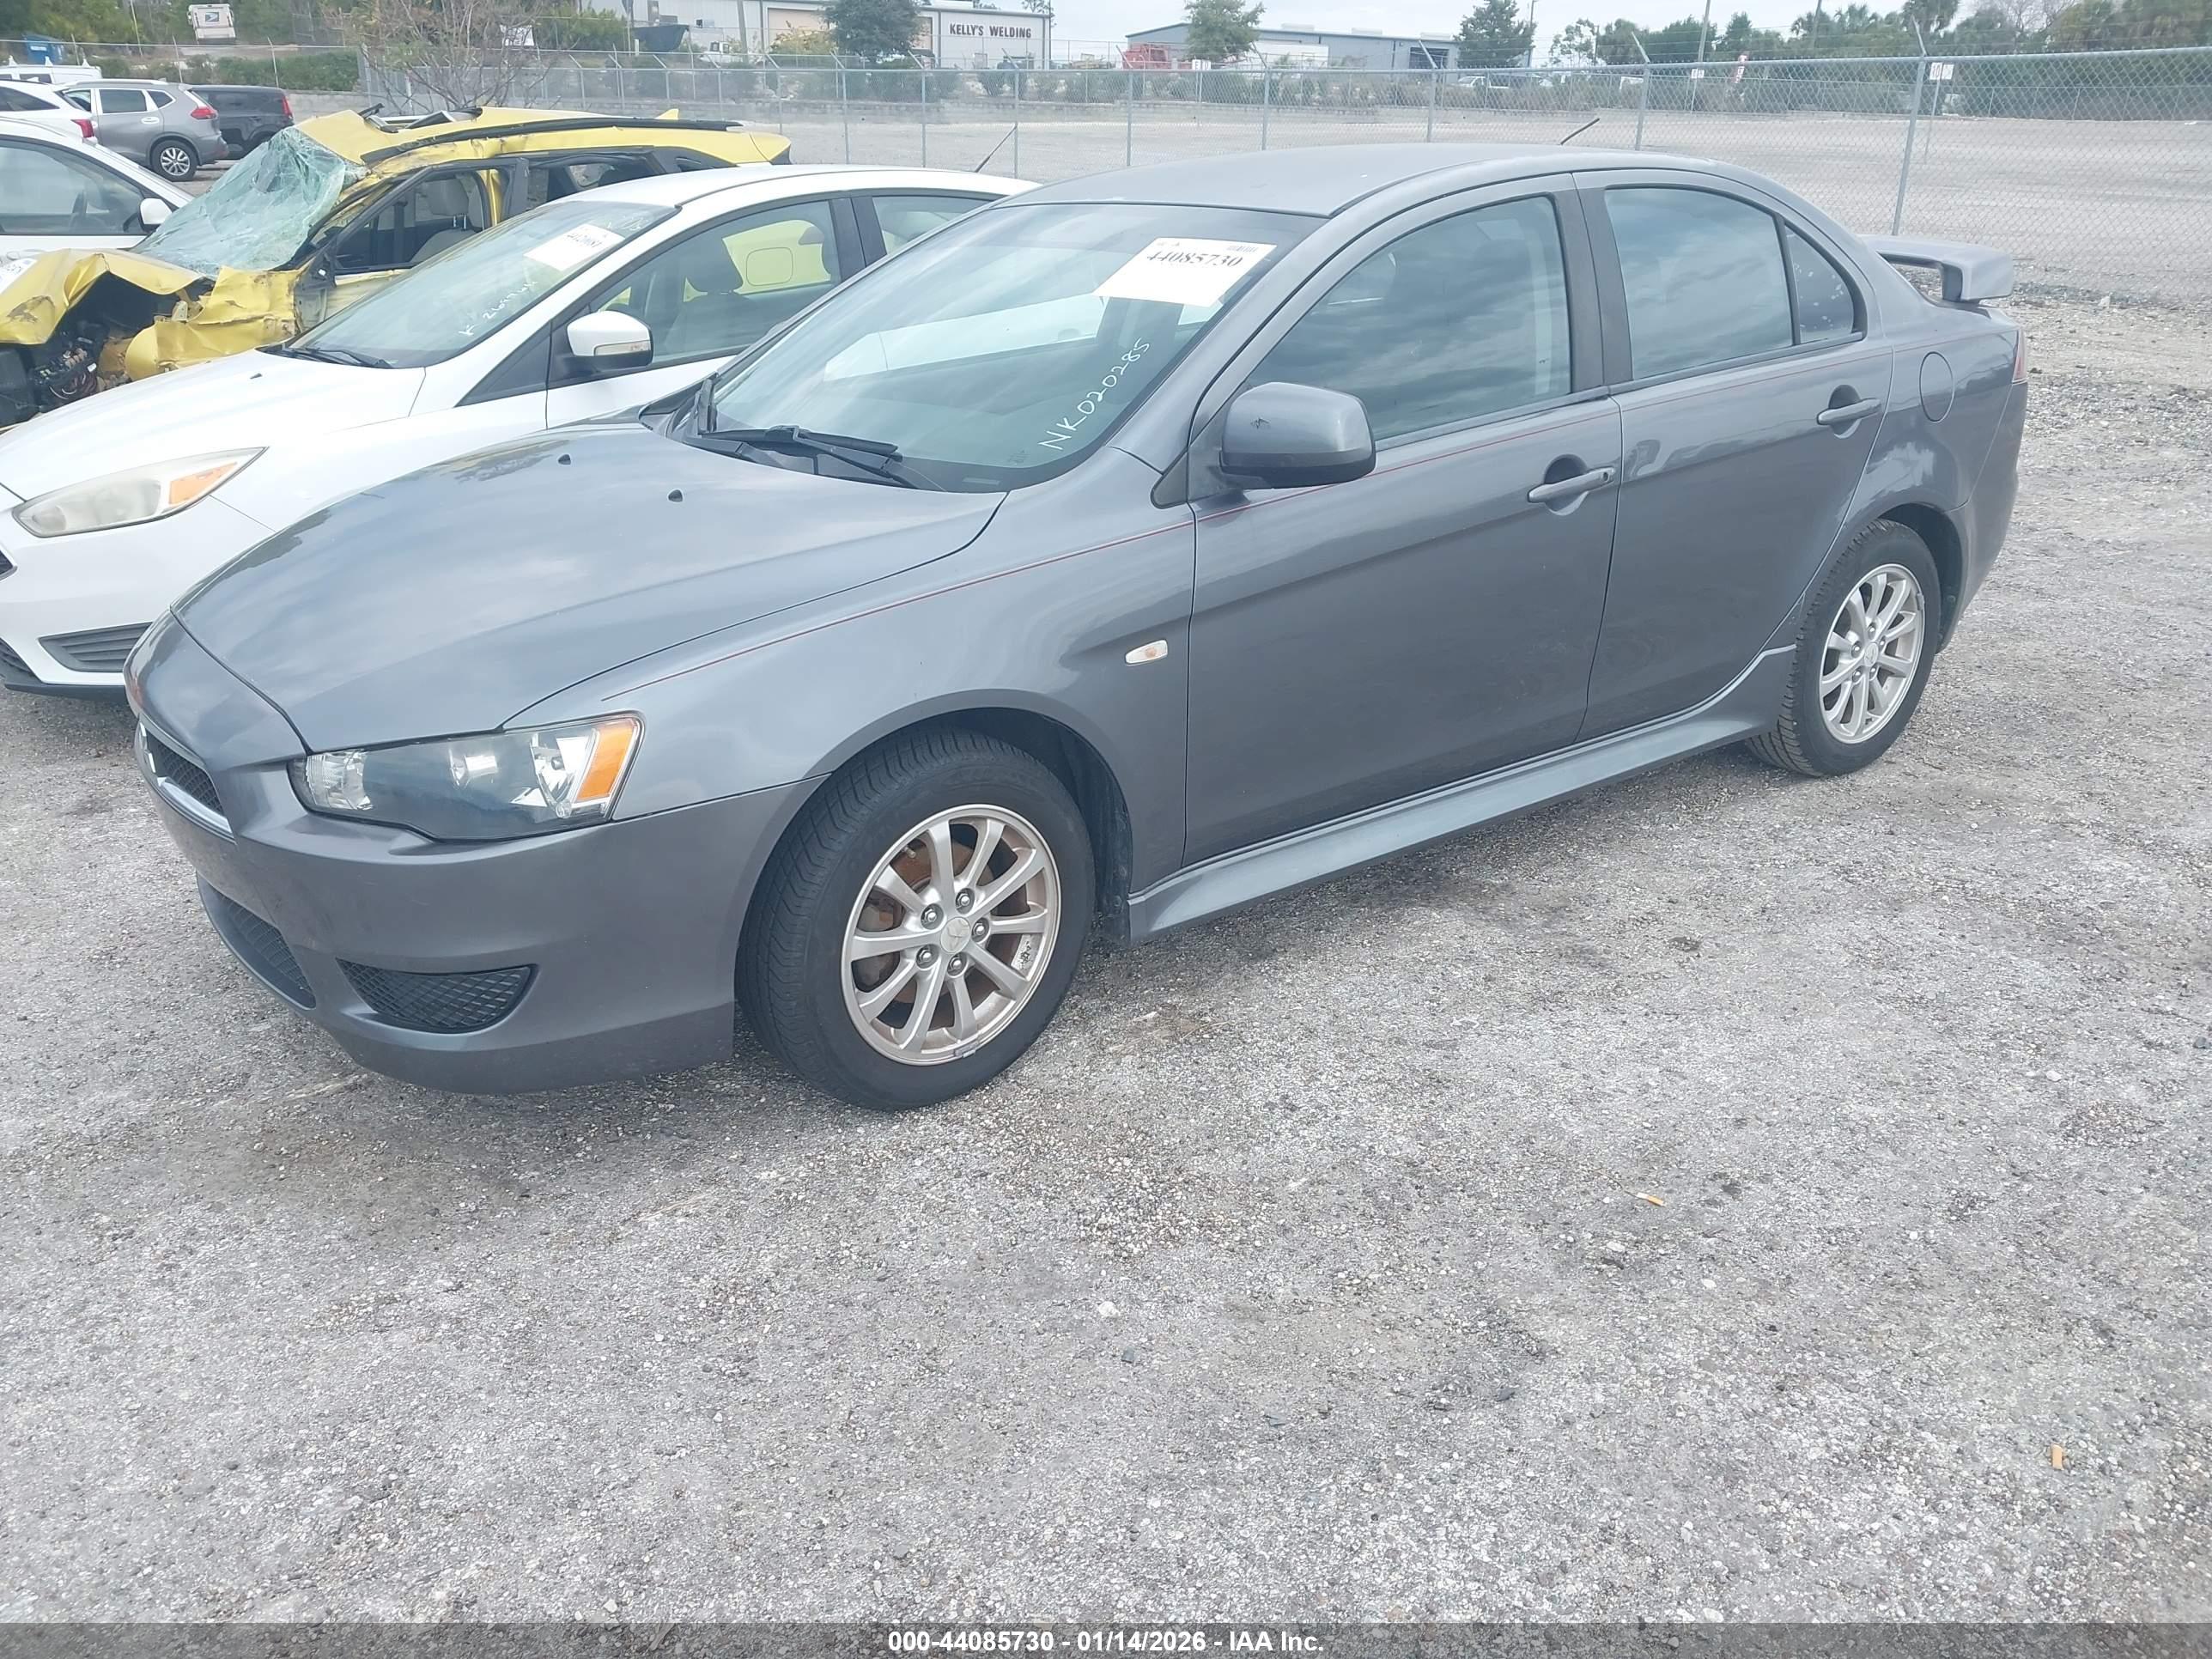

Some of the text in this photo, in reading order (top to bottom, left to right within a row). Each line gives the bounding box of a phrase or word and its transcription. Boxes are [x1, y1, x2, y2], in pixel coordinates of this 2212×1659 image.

[950, 23, 1032, 38] KELLY'S WELDING
[1146, 251, 1243, 267] 44085730
